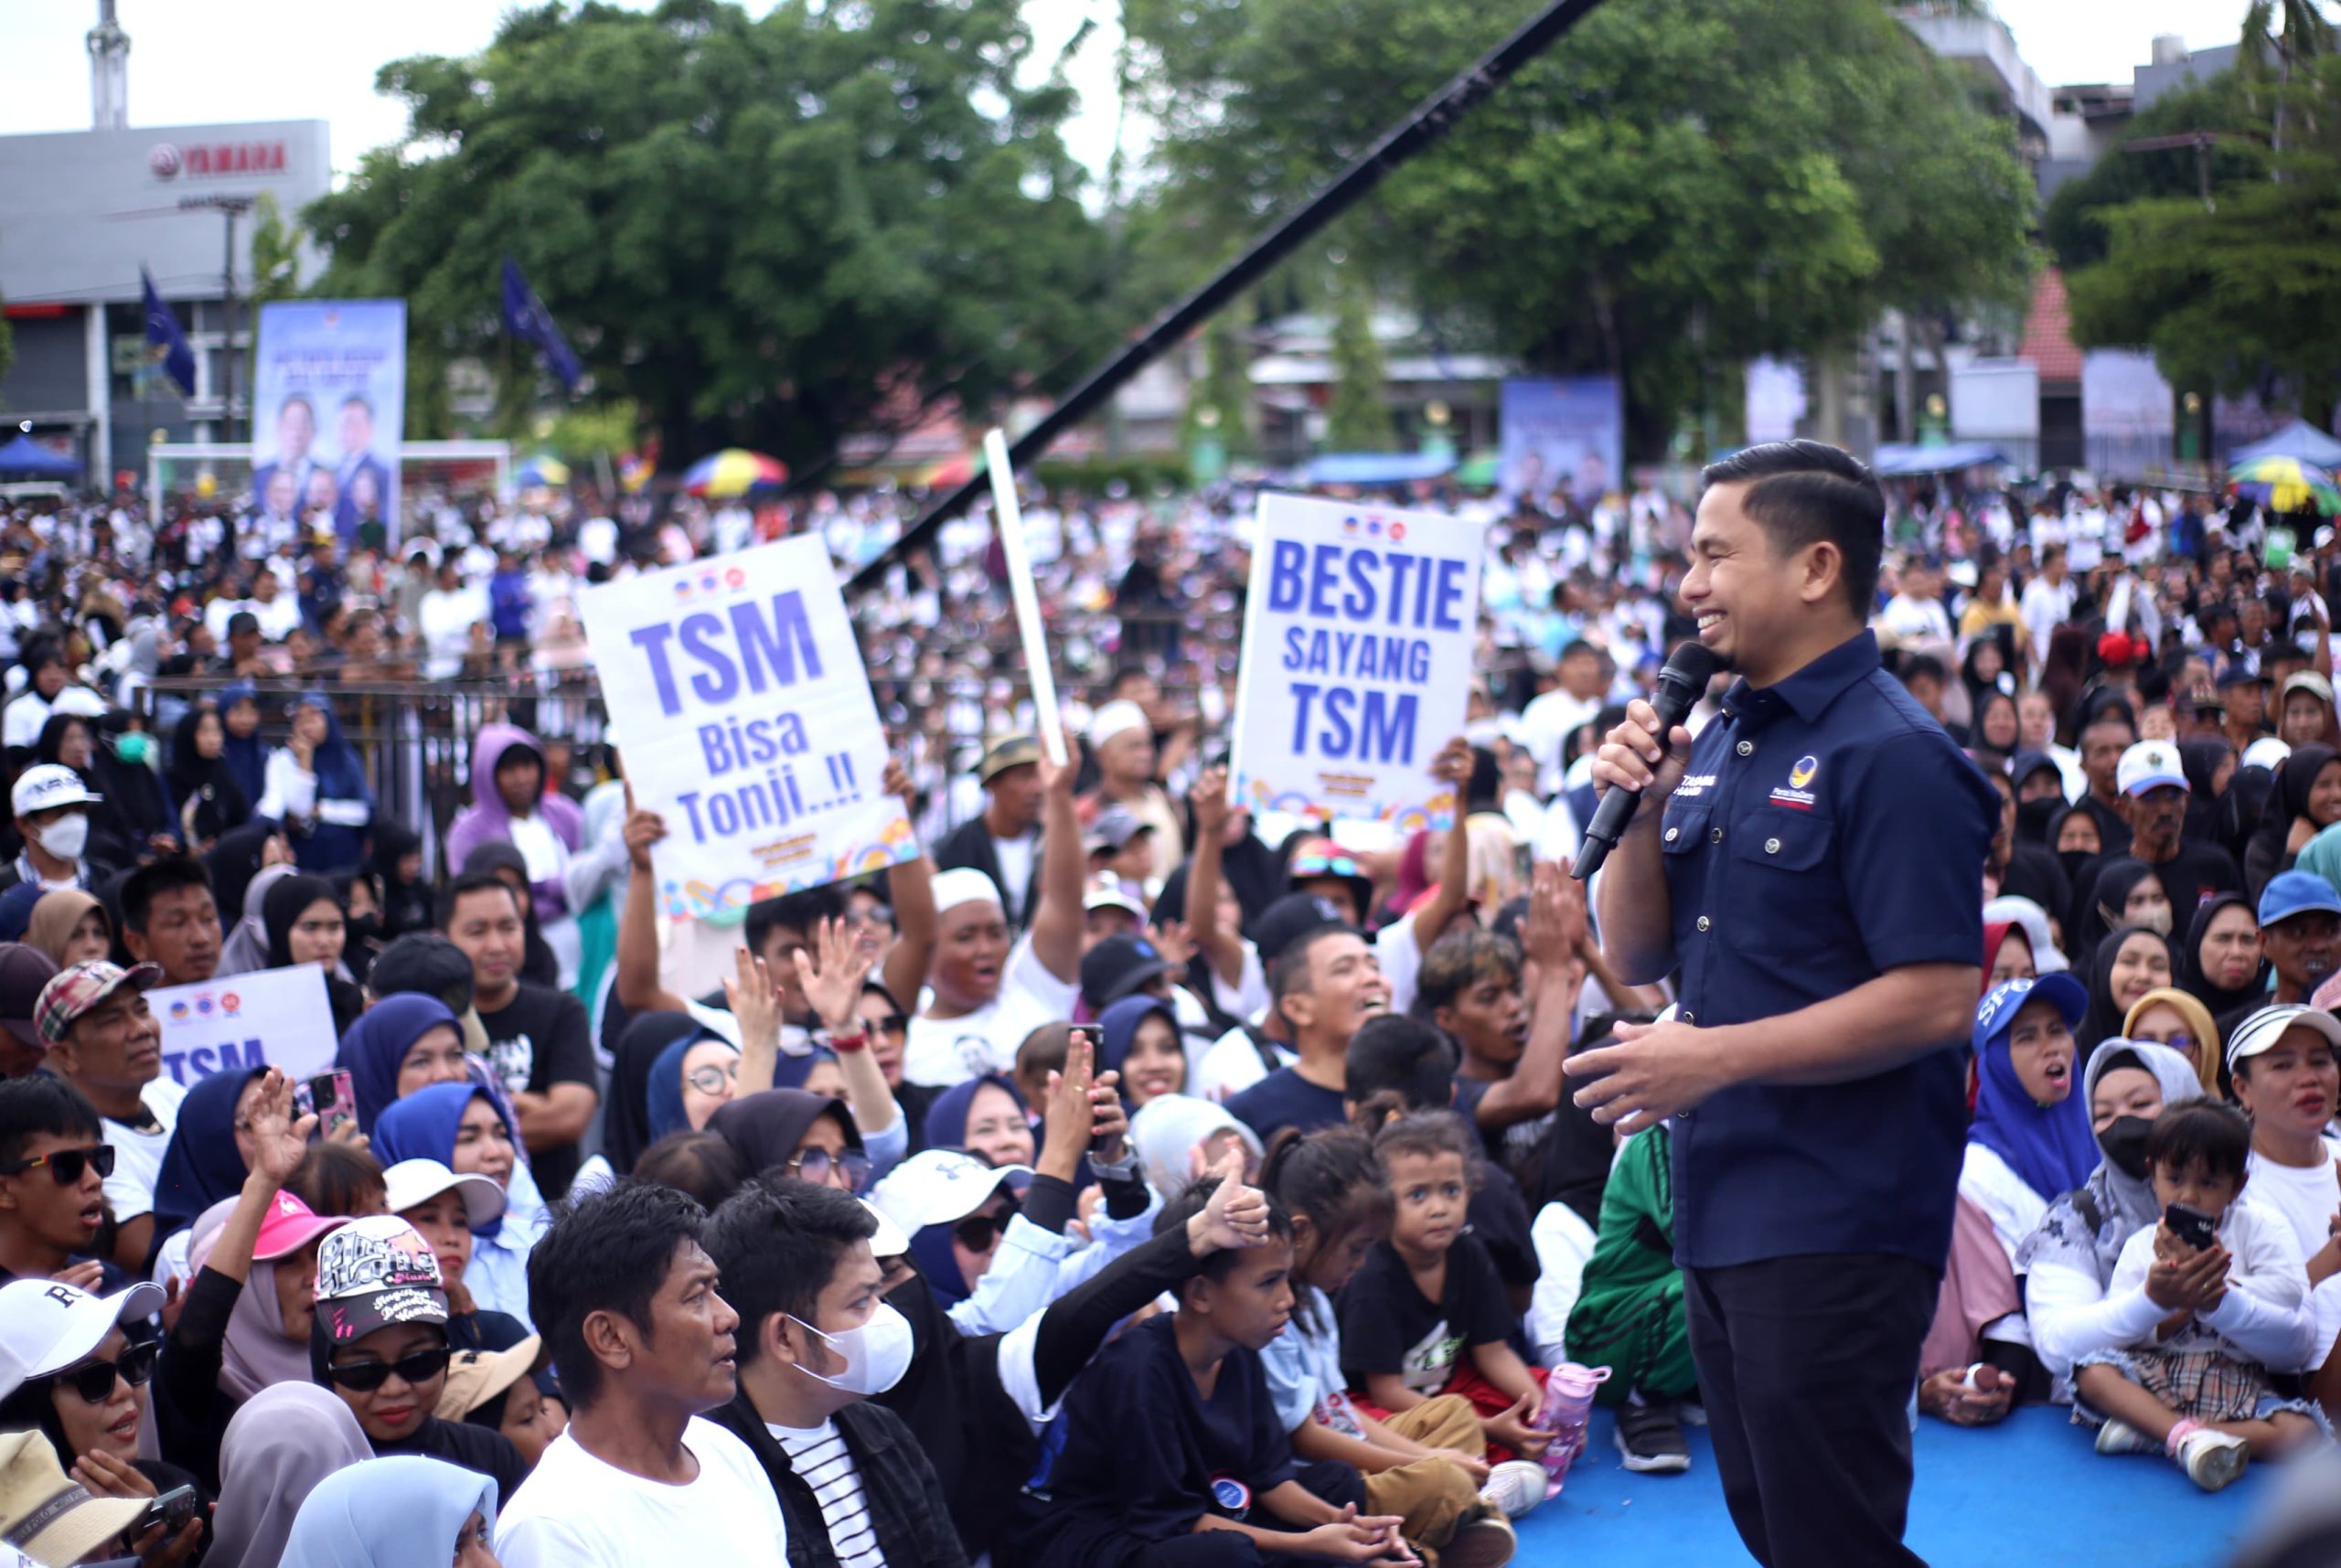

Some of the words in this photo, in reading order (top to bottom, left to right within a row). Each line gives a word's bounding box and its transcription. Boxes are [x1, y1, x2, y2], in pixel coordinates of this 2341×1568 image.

[1267, 539, 1467, 633] BESTIE
[628, 590, 825, 719] TSM
[1283, 625, 1430, 685] SAYANG
[698, 711, 809, 778] Bisa
[1290, 683, 1420, 766] TSM
[44, 1285, 83, 1308] R
